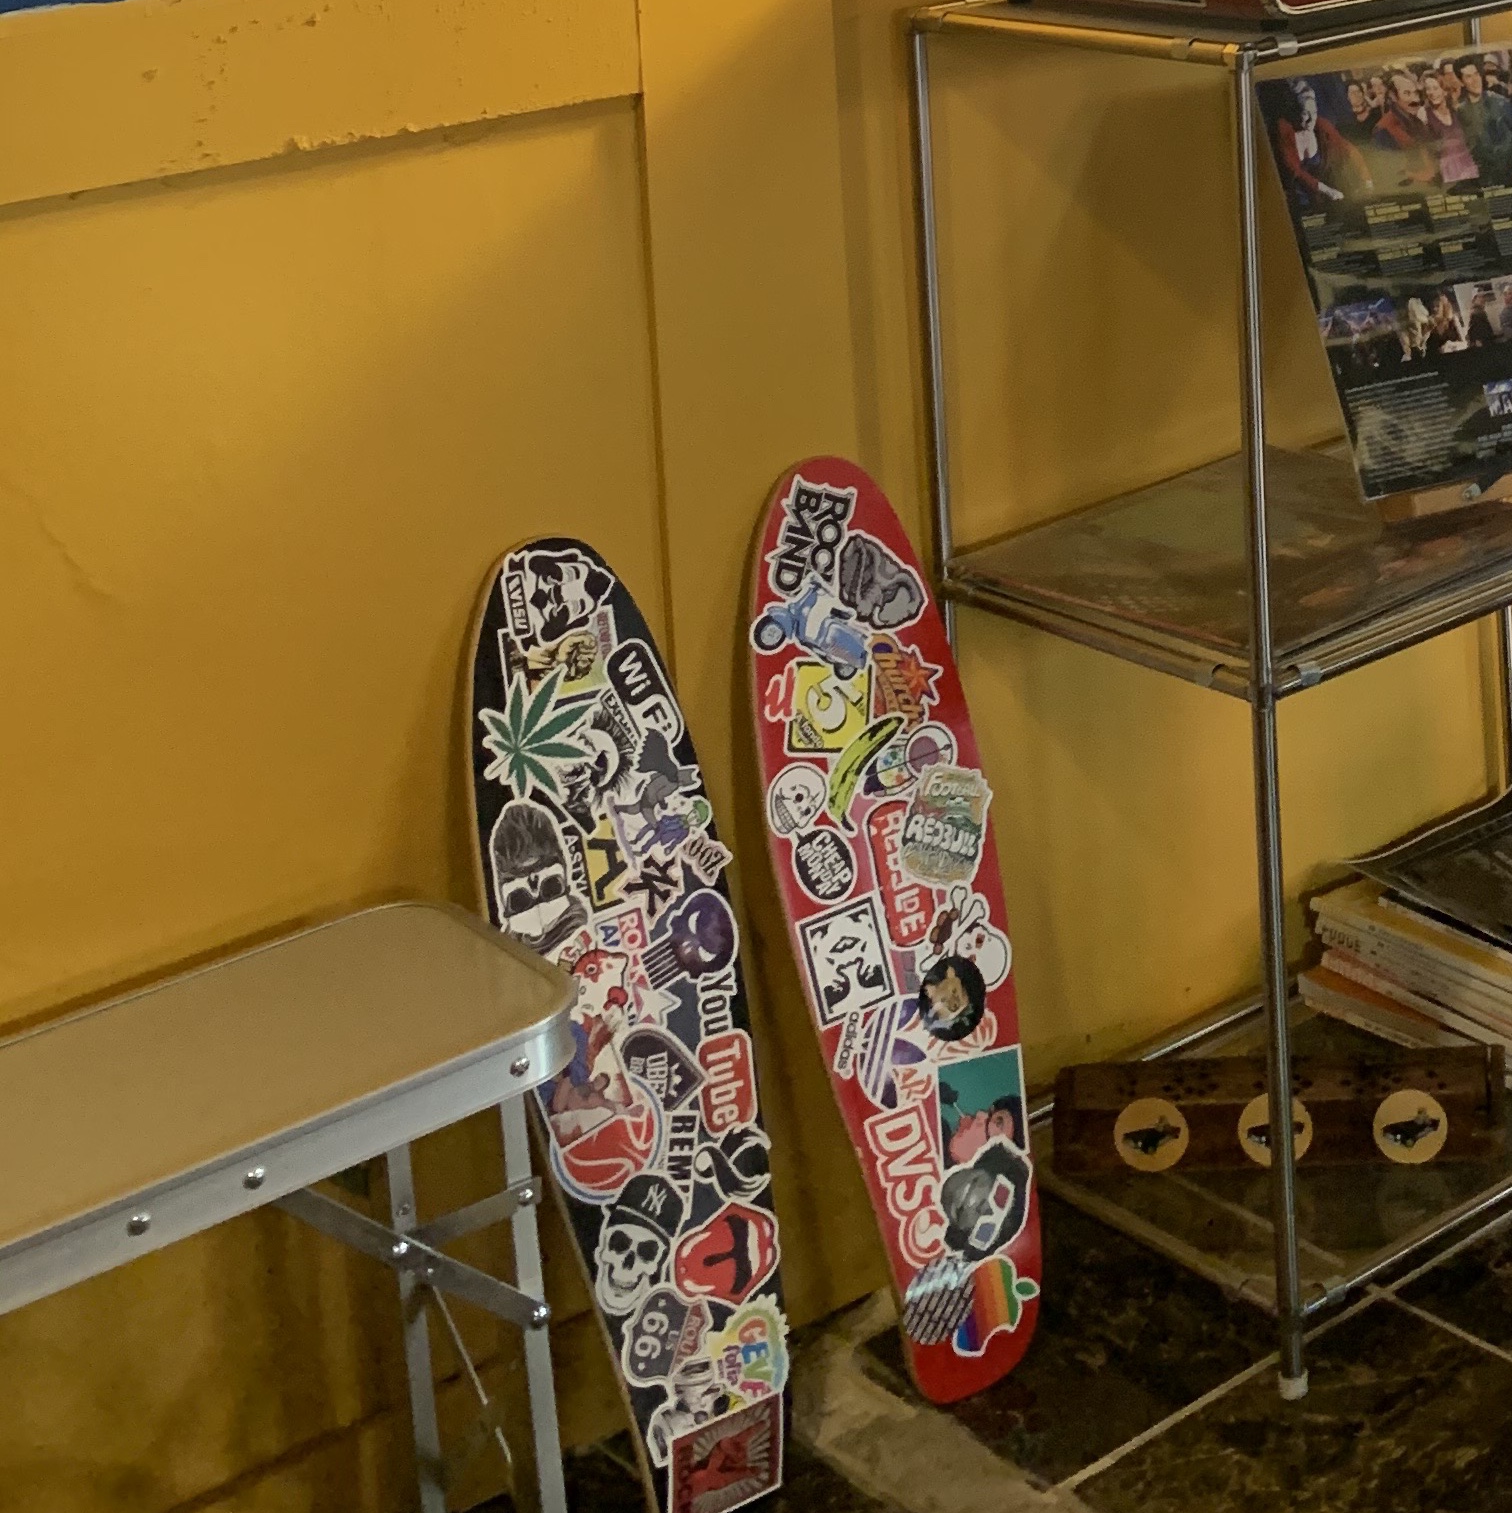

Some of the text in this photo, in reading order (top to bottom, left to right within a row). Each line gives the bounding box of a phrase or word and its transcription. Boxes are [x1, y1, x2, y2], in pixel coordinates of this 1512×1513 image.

[776, 489, 822, 592] BAND
[797, 842, 841, 896] MONDAY
[812, 831, 852, 884] CHEAP
[837, 1011, 859, 1070] adidas
[877, 1116, 933, 1212] DVS
[634, 1310, 670, 1360] 66
